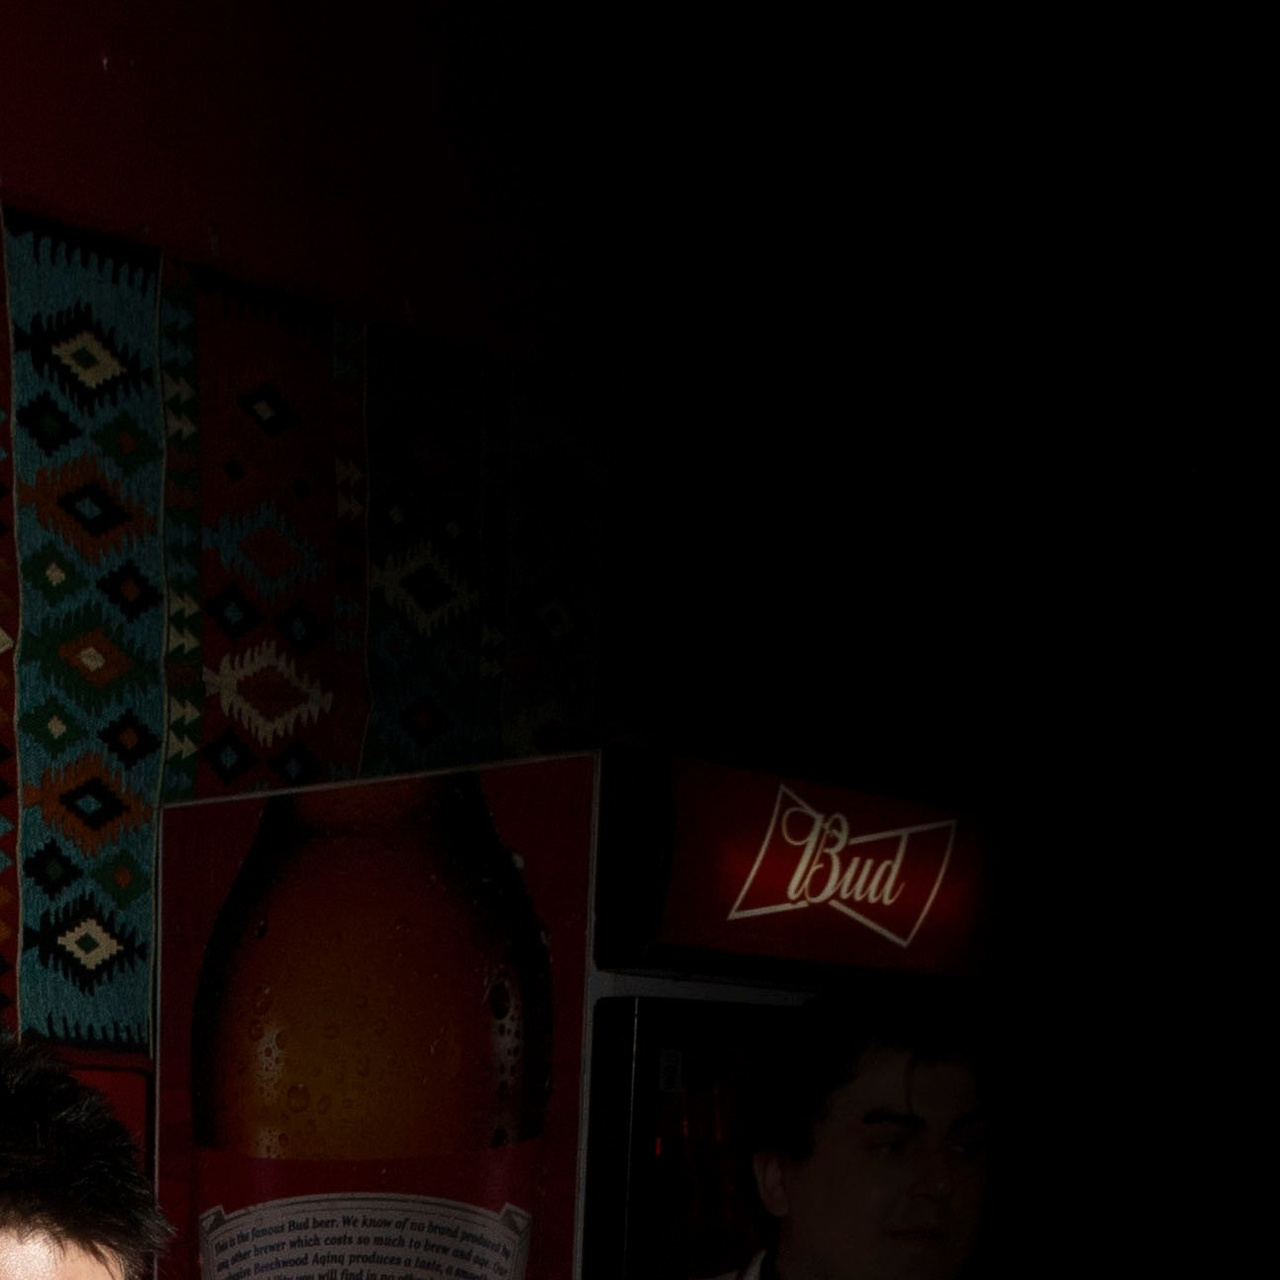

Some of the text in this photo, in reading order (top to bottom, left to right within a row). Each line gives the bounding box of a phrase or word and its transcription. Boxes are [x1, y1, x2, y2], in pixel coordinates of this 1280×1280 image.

[782, 806, 905, 906] Bud
[230, 1249, 252, 1266] other
[253, 1241, 286, 1256] brewer
[289, 1235, 321, 1249] which
[324, 1234, 353, 1246] costs
[356, 1235, 370, 1245] so
[373, 1235, 405, 1247] much
[409, 1238, 422, 1250] to
[424, 1240, 450, 1254] brew
[452, 1246, 473, 1261] and
[237, 1231, 249, 1242] the
[251, 1223, 285, 1239] famous
[288, 1220, 309, 1232] Bud
[312, 1217, 339, 1229] beer.
[342, 1216, 358, 1228] We
[361, 1215, 391, 1228] know
[395, 1217, 409, 1231] of
[410, 1221, 426, 1231] no
[427, 1222, 459, 1238] brand
[461, 1230, 502, 1253] produced
[254, 1254, 308, 1273] Beechwood
[348, 1251, 400, 1266] produces
[366, 1270, 377, 1280] in
